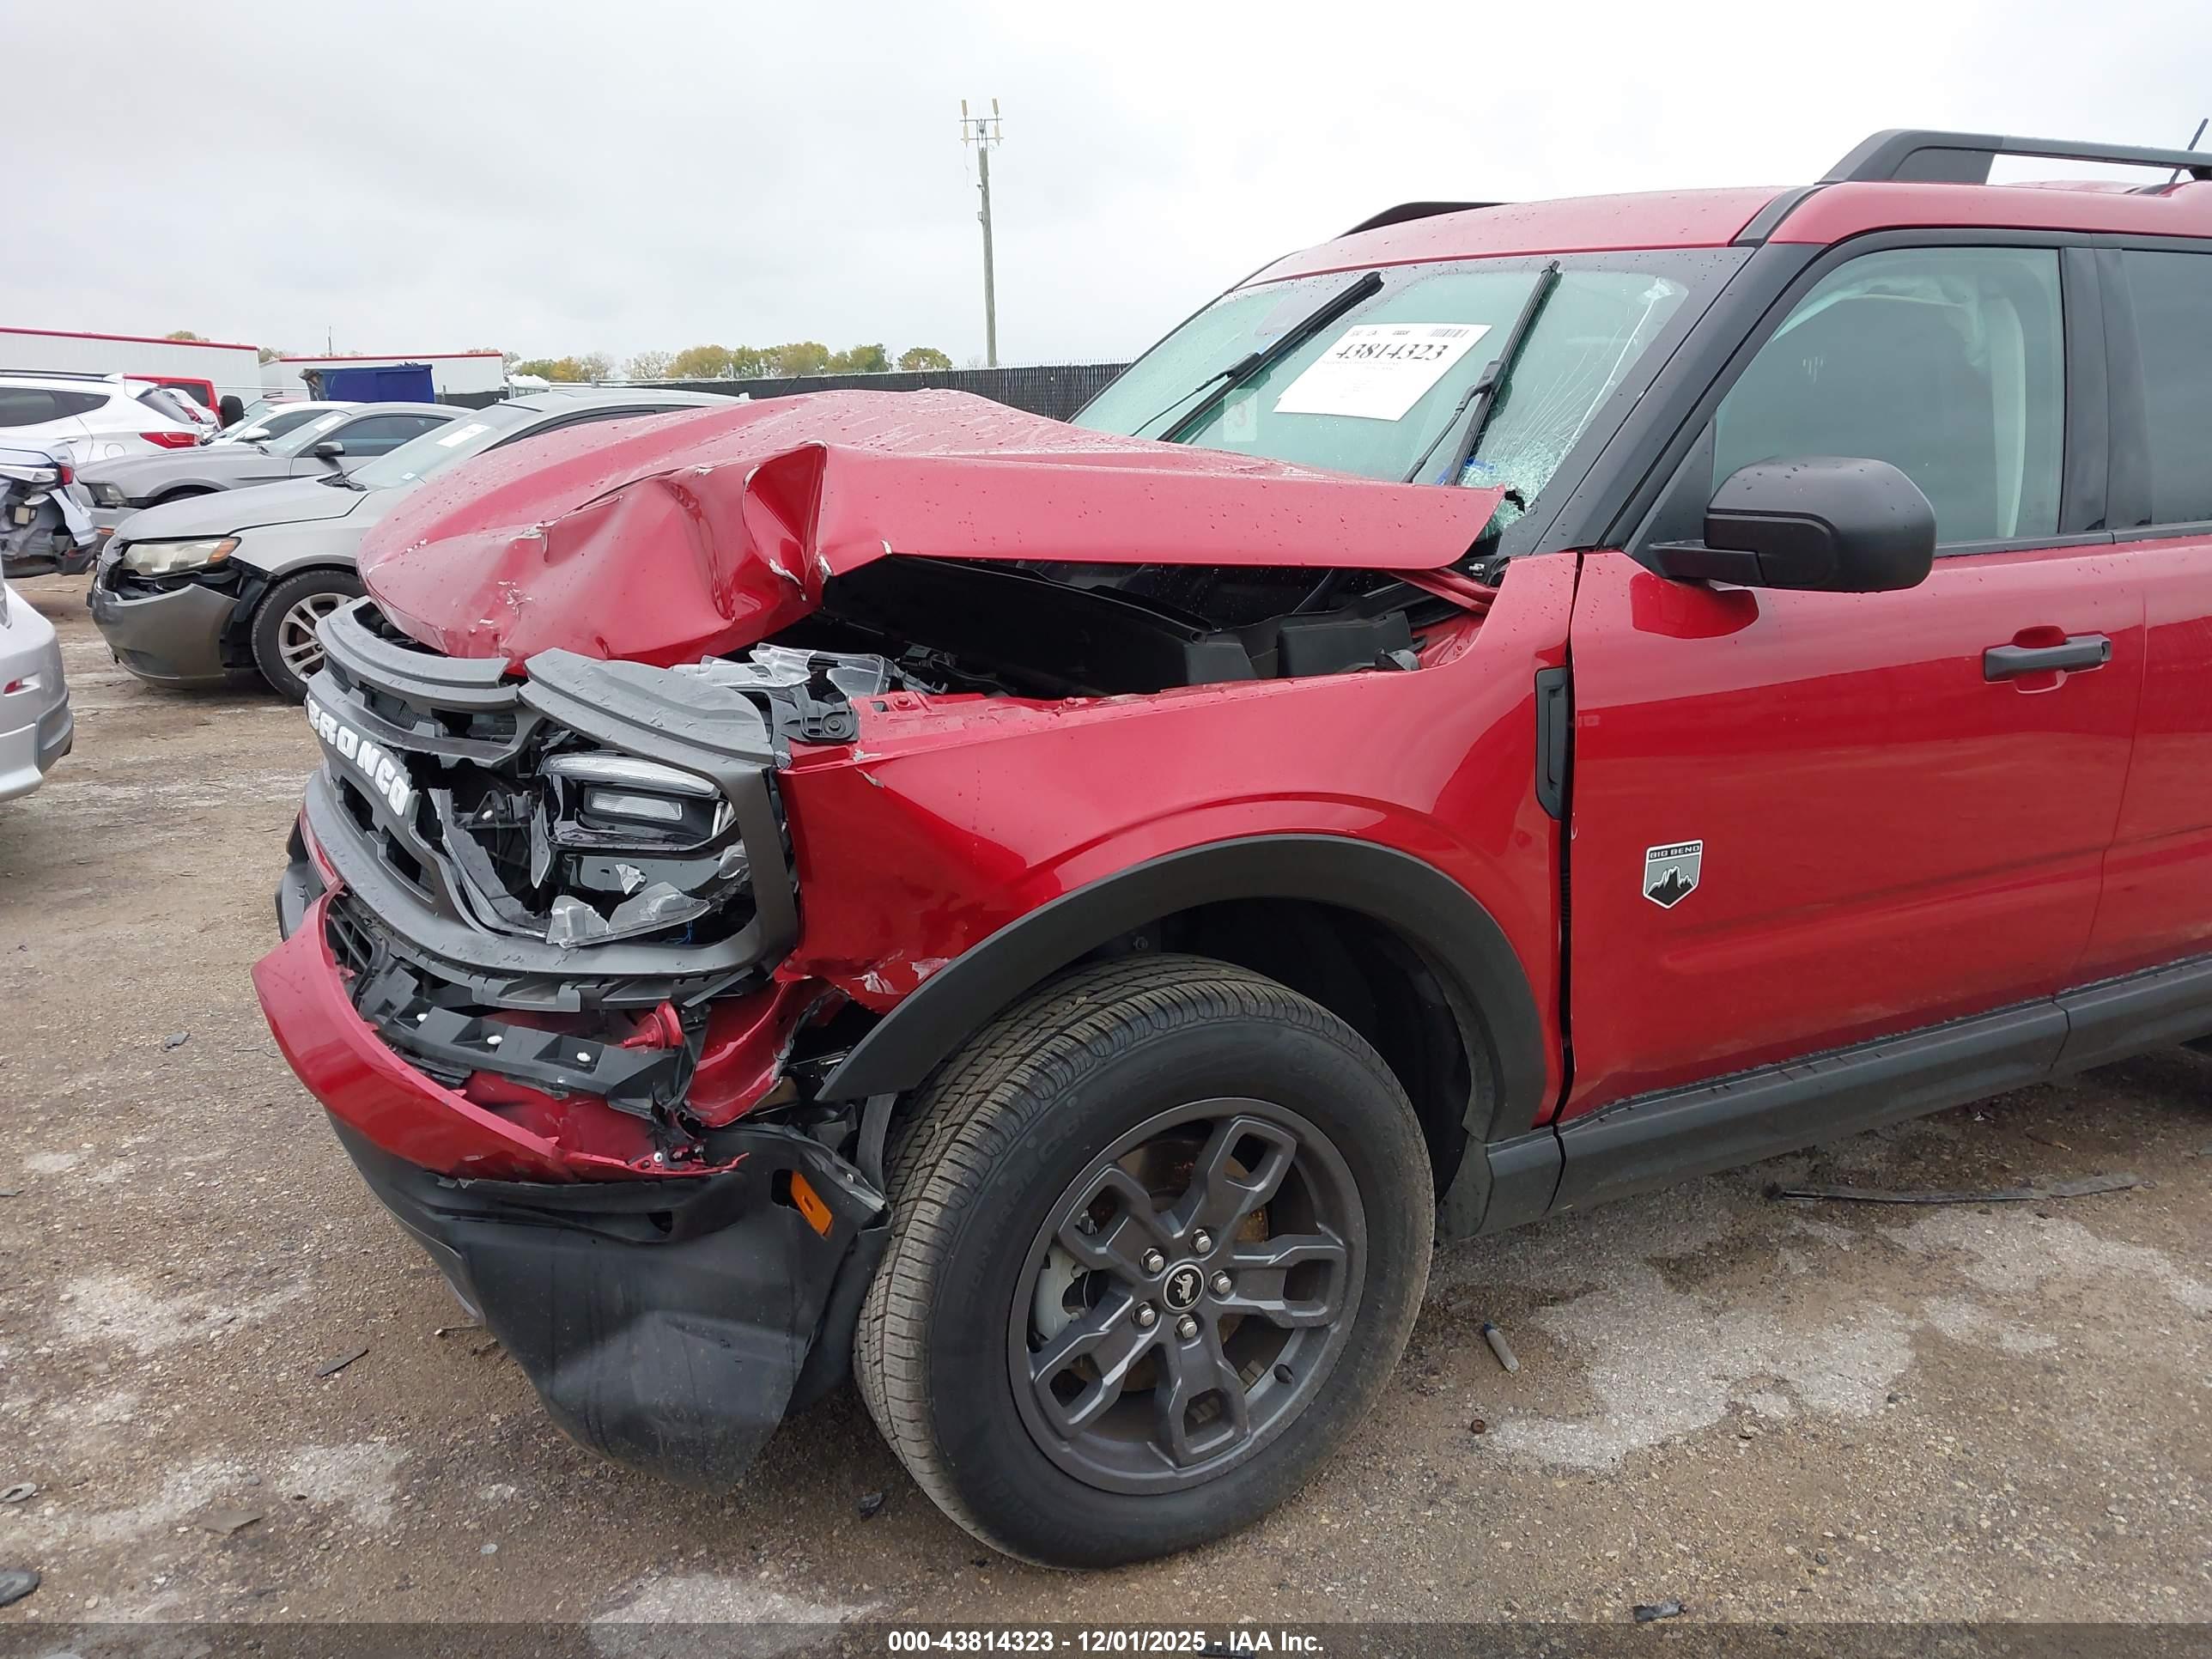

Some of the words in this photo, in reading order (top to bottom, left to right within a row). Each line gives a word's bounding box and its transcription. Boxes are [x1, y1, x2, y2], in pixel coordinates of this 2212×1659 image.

[1336, 343, 1449, 361] 43814323
[308, 699, 410, 816] BRONCO
[1650, 850, 1668, 859] BIG
[1670, 845, 1700, 856] BEND
